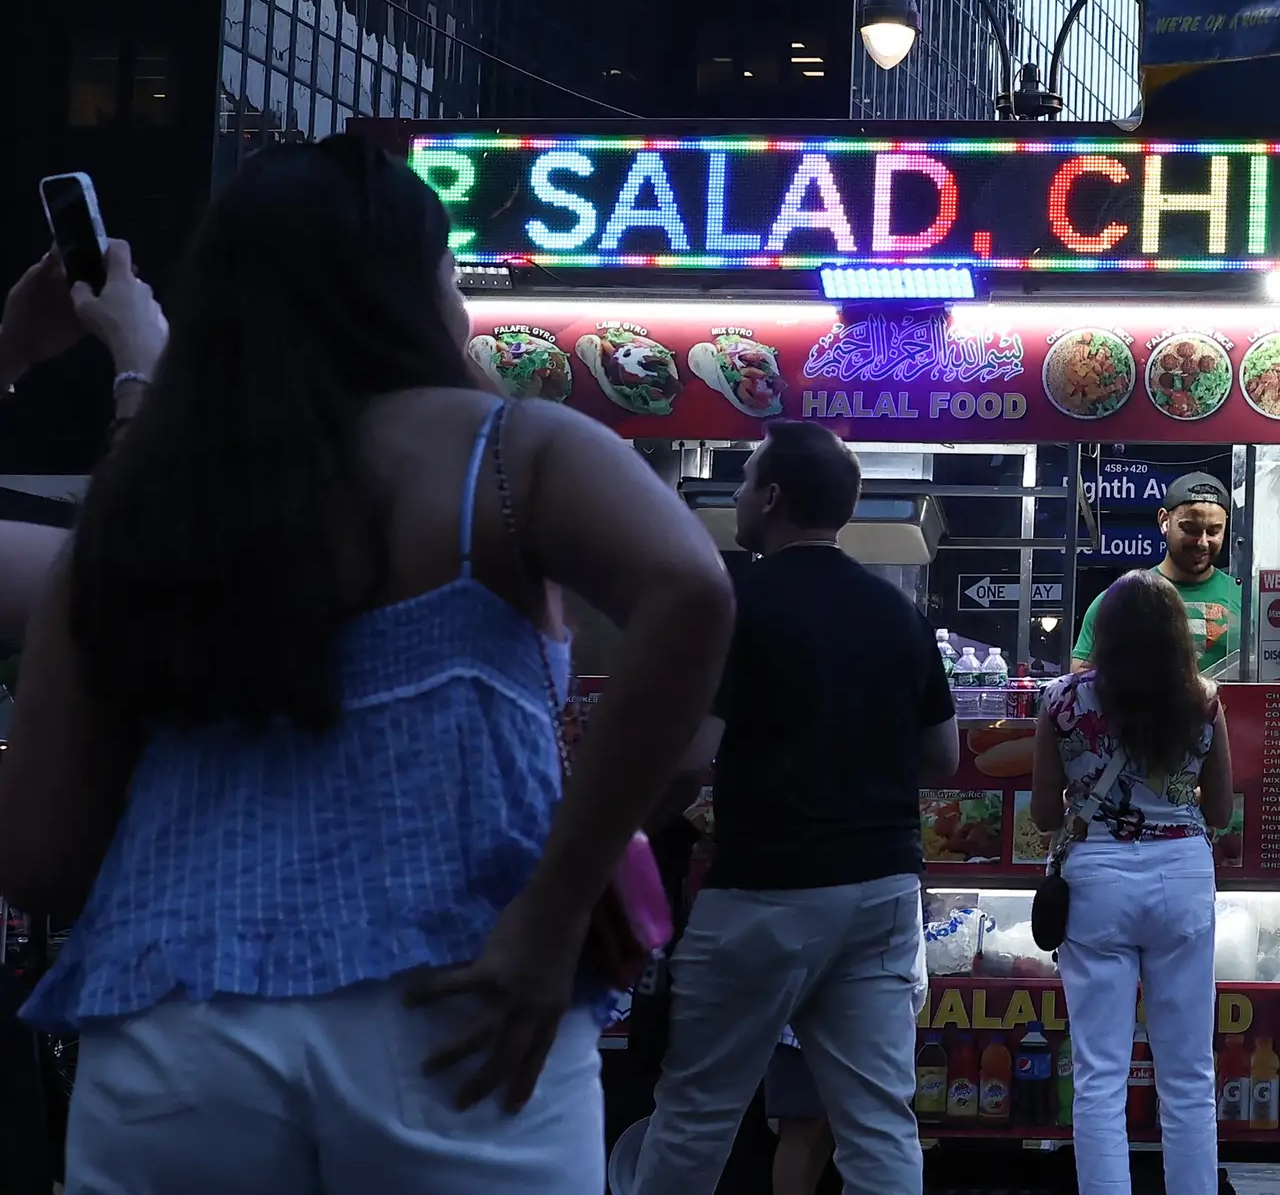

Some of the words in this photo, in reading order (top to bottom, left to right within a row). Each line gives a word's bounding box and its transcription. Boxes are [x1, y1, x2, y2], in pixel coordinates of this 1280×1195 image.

[523, 150, 990, 259] SALAD,
[493, 324, 531, 335] FALAFEL
[531, 327, 557, 344] GYRO
[595, 321, 621, 330] LAMB
[622, 322, 648, 336] GYRO
[710, 327, 727, 336] MIX
[727, 327, 753, 338] GYRO
[801, 390, 919, 419] HALAL
[929, 391, 1028, 420] FOOD
[1104, 463, 1122, 473] 458
[1129, 463, 1148, 474] 420
[1101, 534, 1152, 555] Louis
[1263, 573, 1278, 589] WE
[976, 585, 1006, 599] ONE
[1033, 585, 1054, 599] AY
[1262, 777, 1280, 785] MIX
[1223, 1080, 1242, 1103] G
[1253, 1080, 1272, 1103] G
